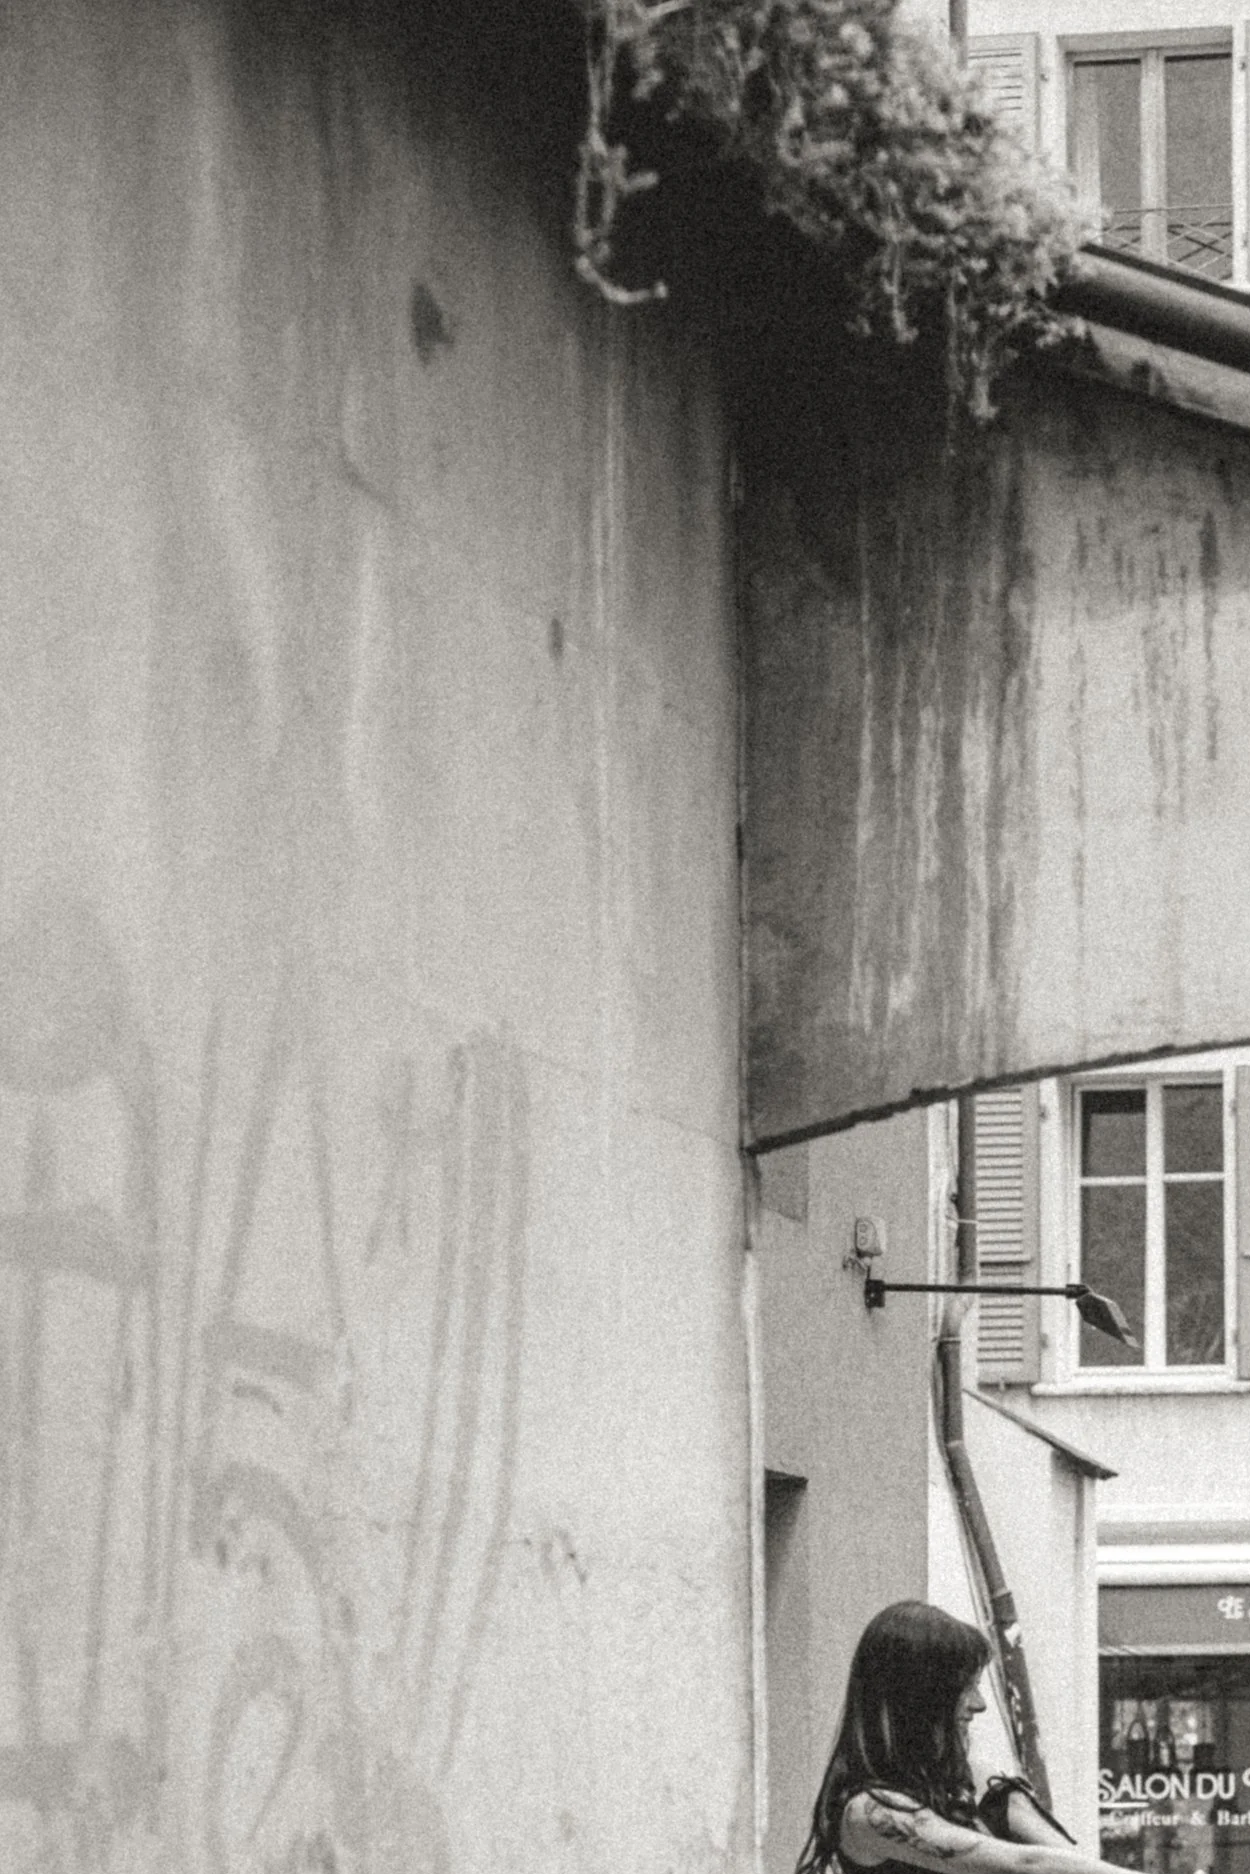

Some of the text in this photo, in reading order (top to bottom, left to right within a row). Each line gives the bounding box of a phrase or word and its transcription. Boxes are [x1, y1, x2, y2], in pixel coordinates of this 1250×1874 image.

[1217, 1595, 1245, 1619] LE
[1098, 1767, 1191, 1803] SALON
[1196, 1772, 1236, 1800] DU
[1190, 1810, 1207, 1827] &
